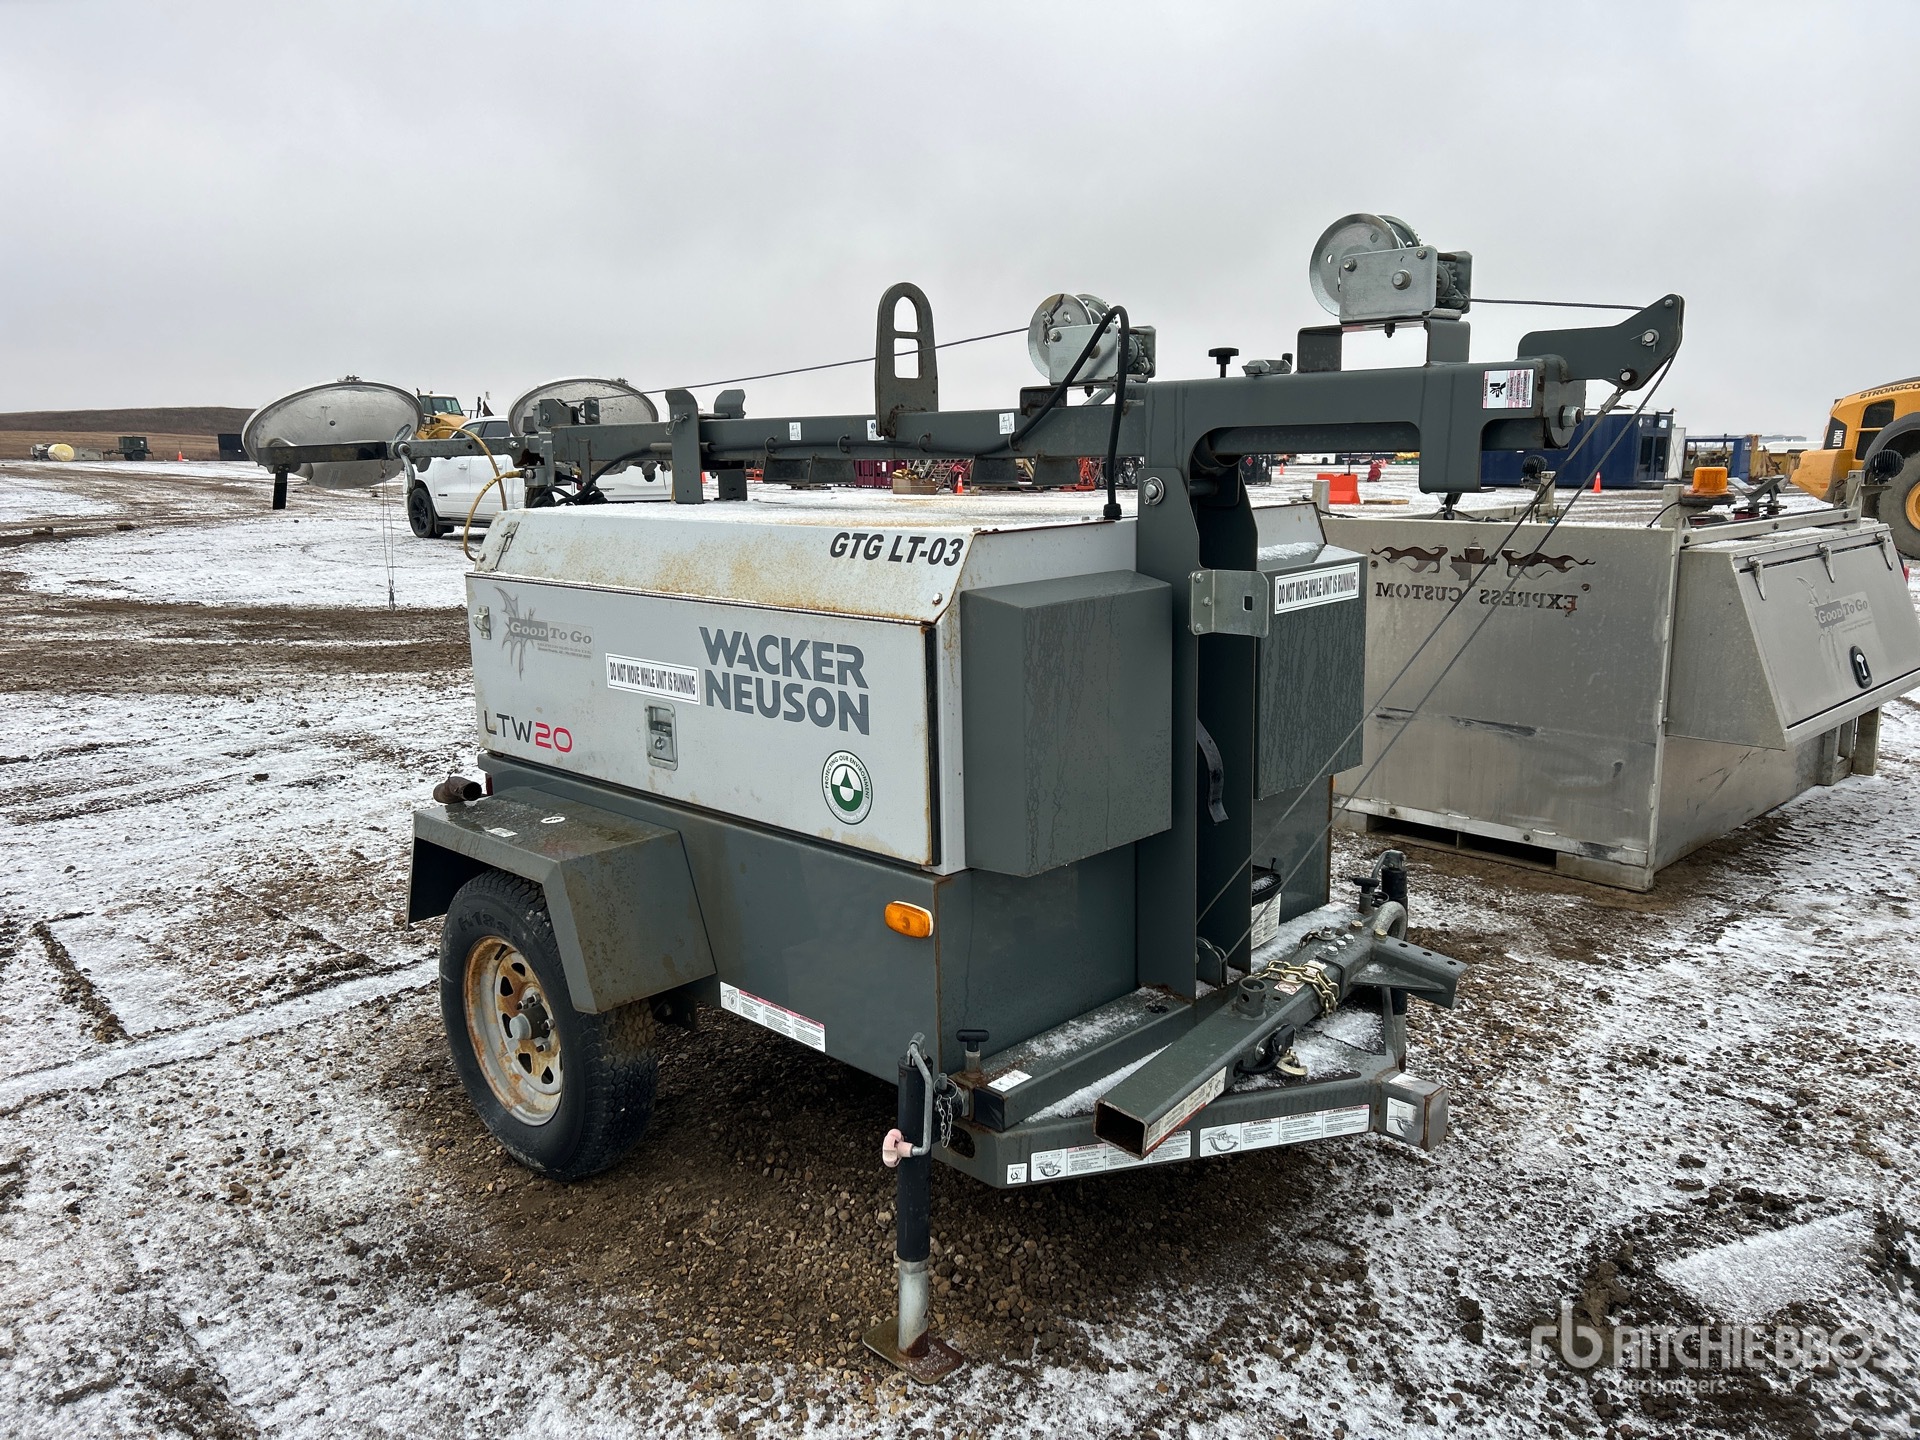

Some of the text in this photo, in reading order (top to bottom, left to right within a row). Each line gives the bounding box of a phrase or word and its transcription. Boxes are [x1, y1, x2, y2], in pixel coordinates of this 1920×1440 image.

[830, 532, 964, 566] GTG LT-03
[1279, 572, 1355, 604] DO NOT MOVE WHILE UNIT IS RUNNING
[610, 662, 695, 695] DO NOT MOVE WHILE UNIT IS RUNNING
[699, 626, 869, 689] WACKER
[705, 669, 869, 735] NEUSON
[484, 710, 572, 753] LTW20
[825, 756, 838, 788] PROTECTING
[850, 758, 869, 799] ENVIRONMENT
